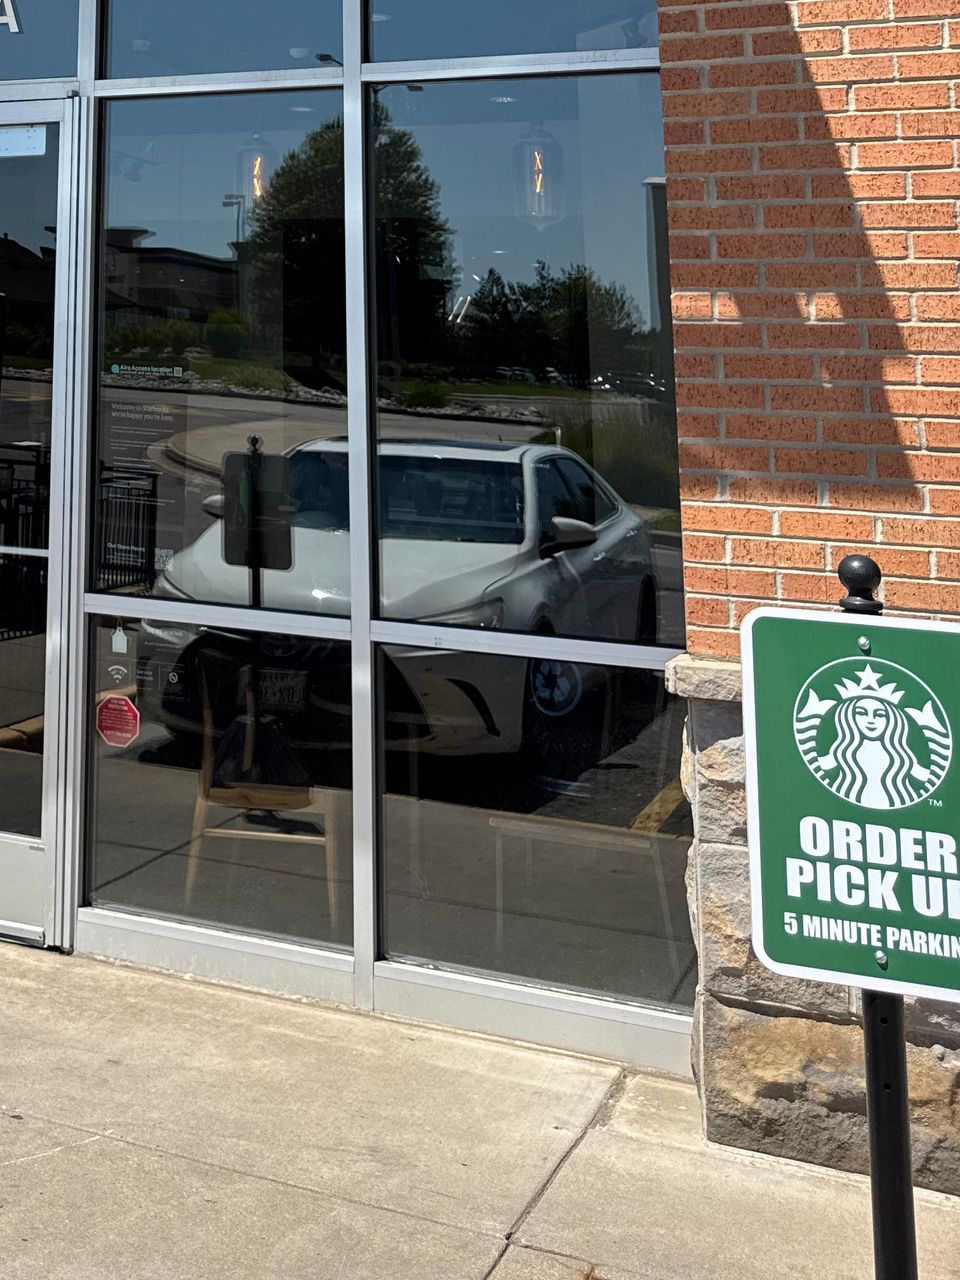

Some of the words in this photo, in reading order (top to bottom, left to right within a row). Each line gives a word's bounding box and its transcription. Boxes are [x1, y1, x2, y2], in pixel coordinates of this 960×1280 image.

[928, 798, 942, 807] TM
[799, 815, 958, 875] ORDER
[785, 857, 902, 912] PICK
[783, 911, 798, 935] 5
[802, 914, 882, 947] MINUTE
